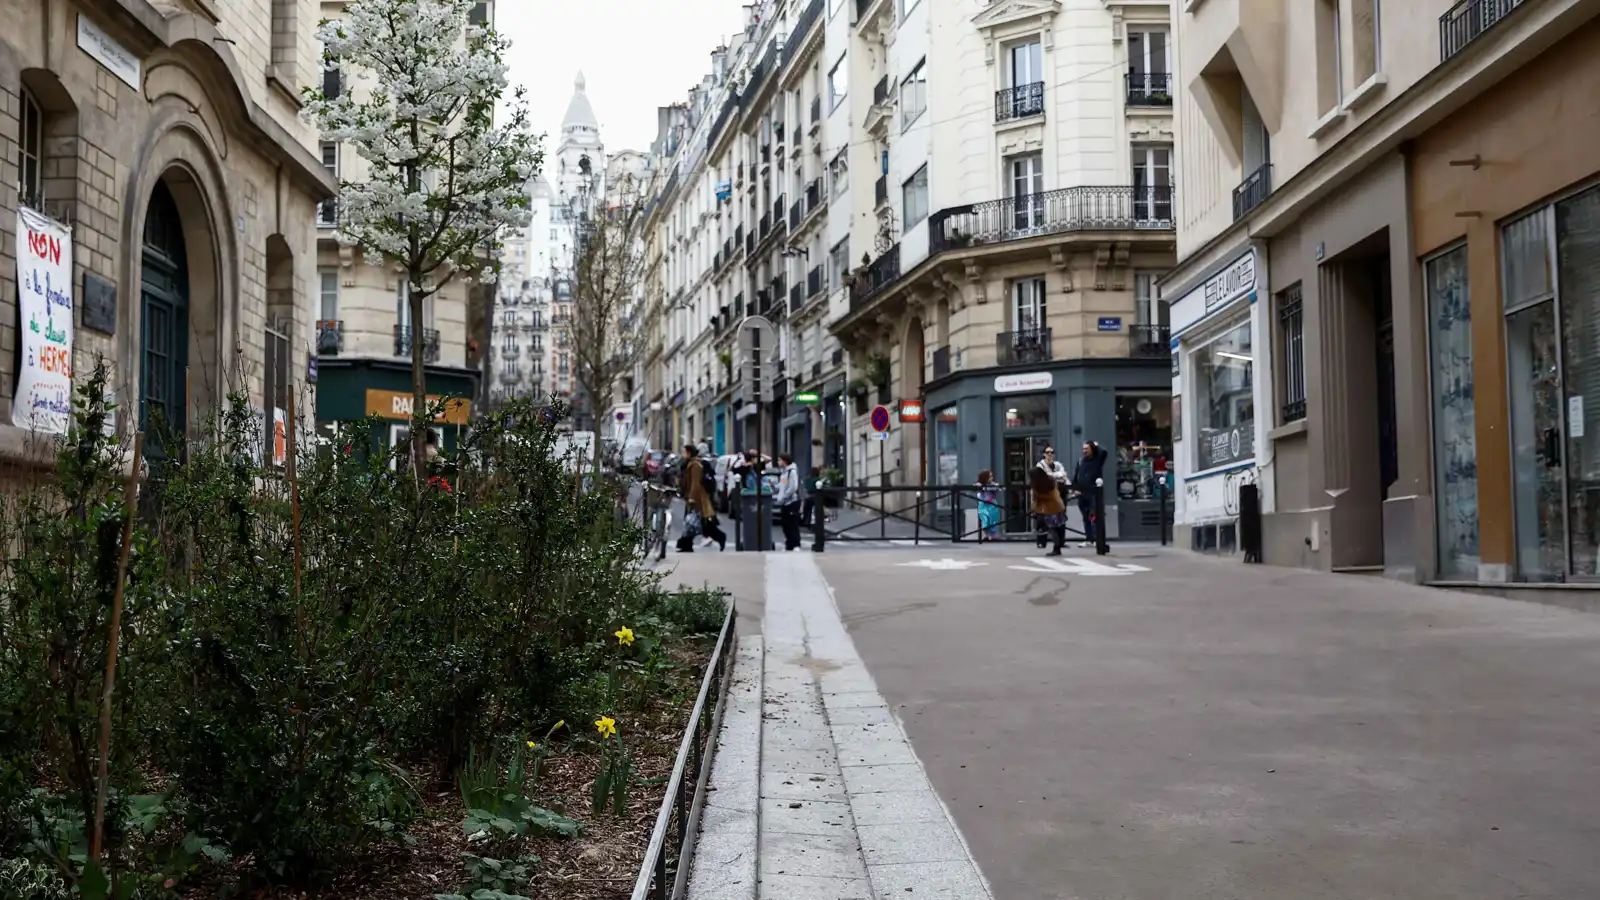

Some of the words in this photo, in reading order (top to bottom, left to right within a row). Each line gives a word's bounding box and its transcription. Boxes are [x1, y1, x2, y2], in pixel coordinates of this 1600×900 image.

[28, 229, 61, 266] NON
[30, 311, 40, 335] de
[28, 345, 34, 367] à
